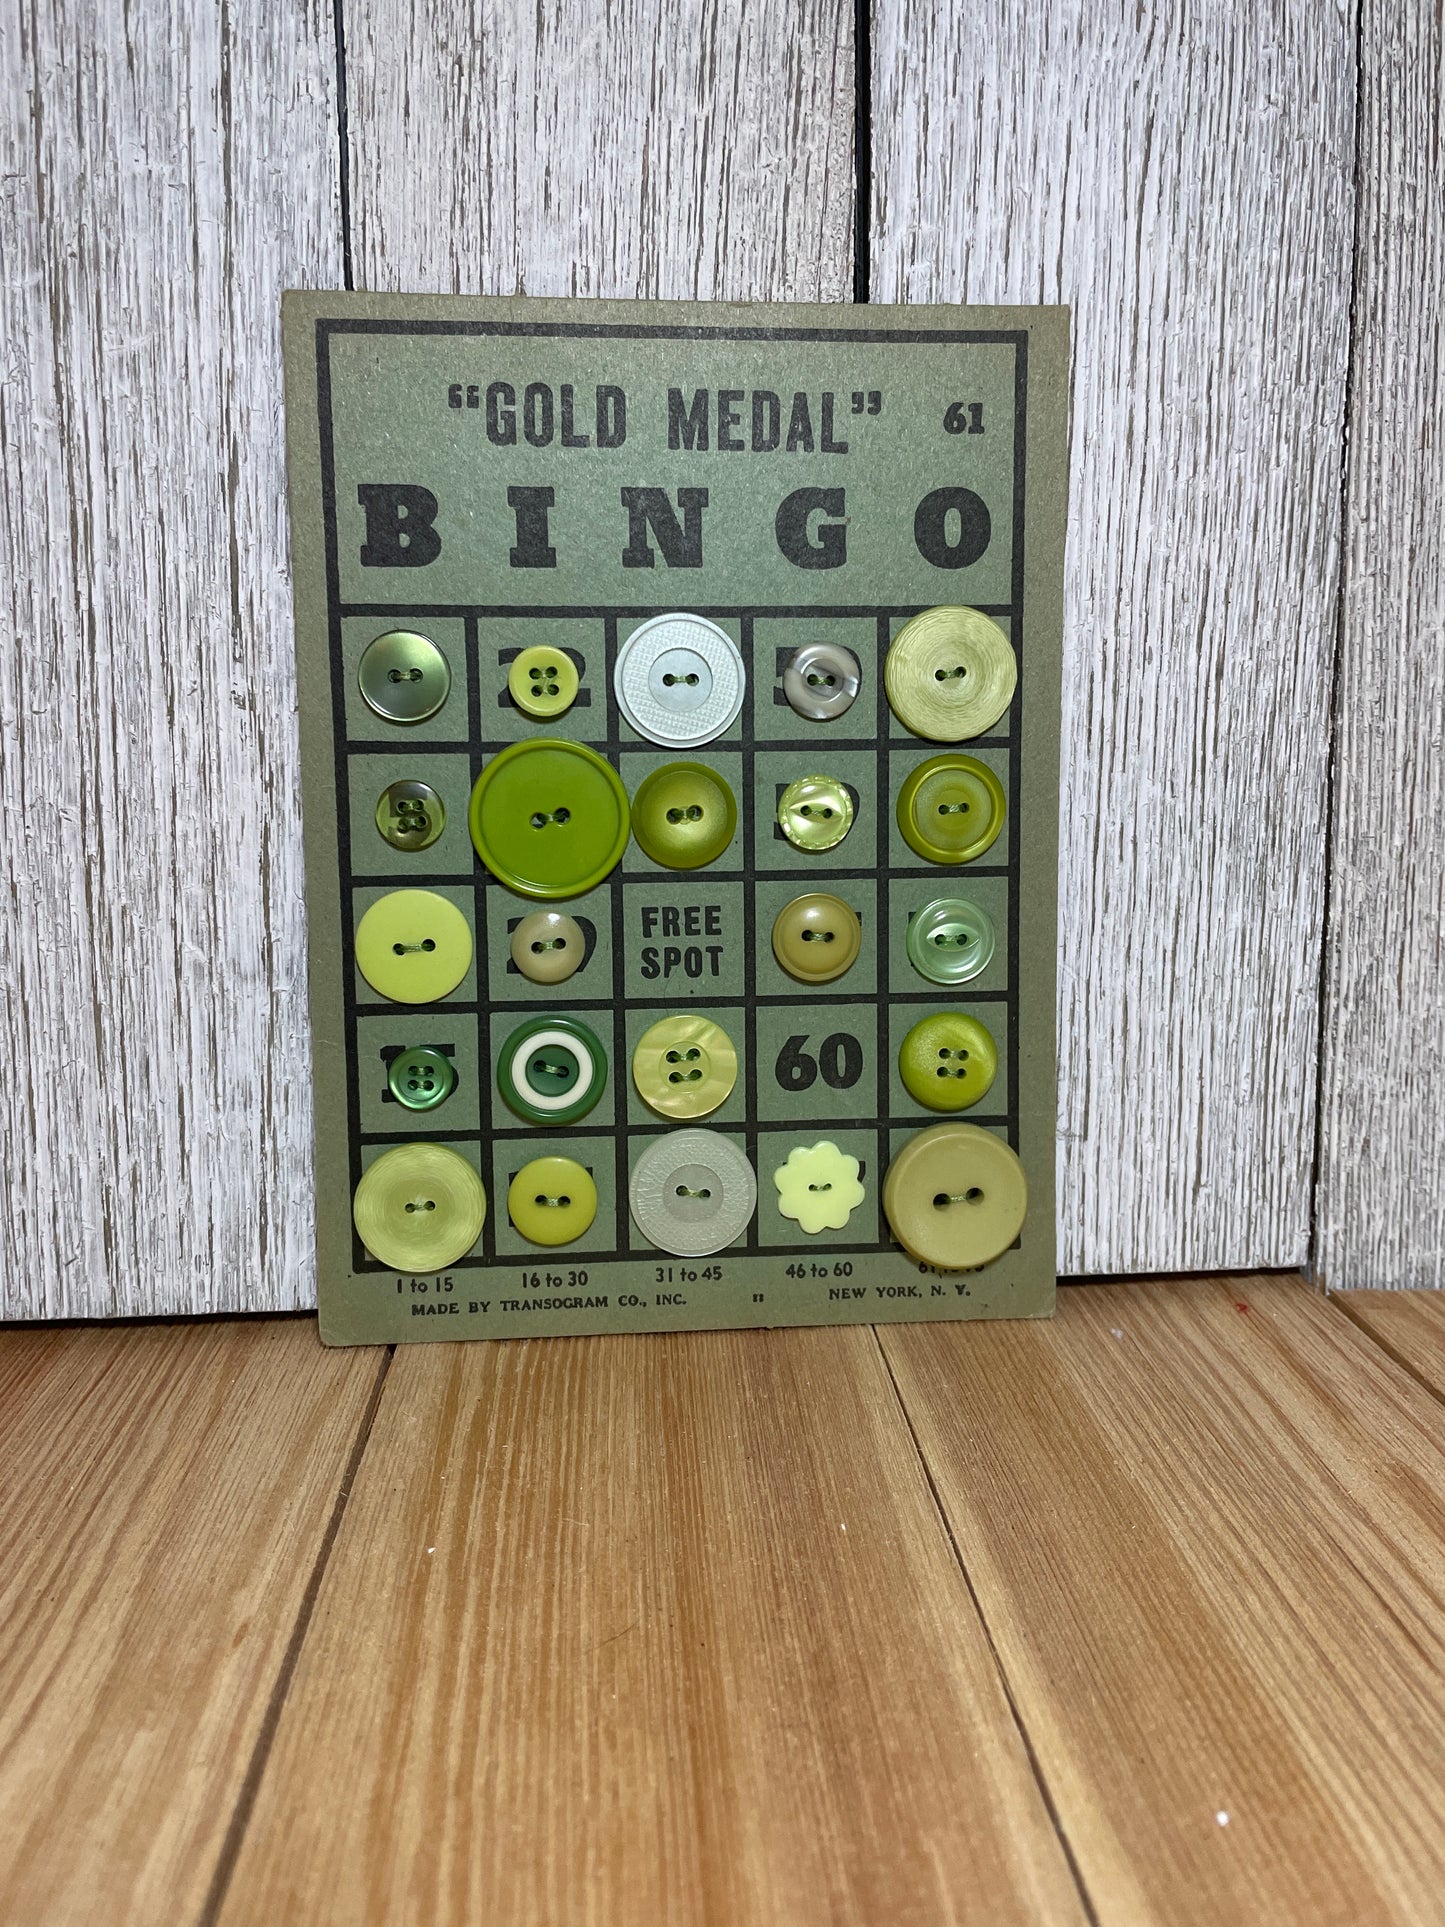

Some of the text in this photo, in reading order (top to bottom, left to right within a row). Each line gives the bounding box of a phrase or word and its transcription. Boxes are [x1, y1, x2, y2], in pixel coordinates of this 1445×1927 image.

[942, 401, 986, 435] 61
[641, 905, 722, 939] FREE
[641, 945, 724, 980] SPOT
[774, 1032, 864, 1092] 60
[522, 1271, 589, 1289] 16 to 30
[655, 1265, 723, 1283] 31 to 45
[785, 1261, 853, 1280] 46 to 60
[410, 1278, 428, 1293] to
[435, 1277, 454, 1293] 15
[828, 1287, 867, 1301] NEW
[875, 1285, 923, 1299] YORK,
[930, 1284, 947, 1297] N.
[411, 1293, 687, 1317] MADE BY TRANSOGRAM CO., INC.
